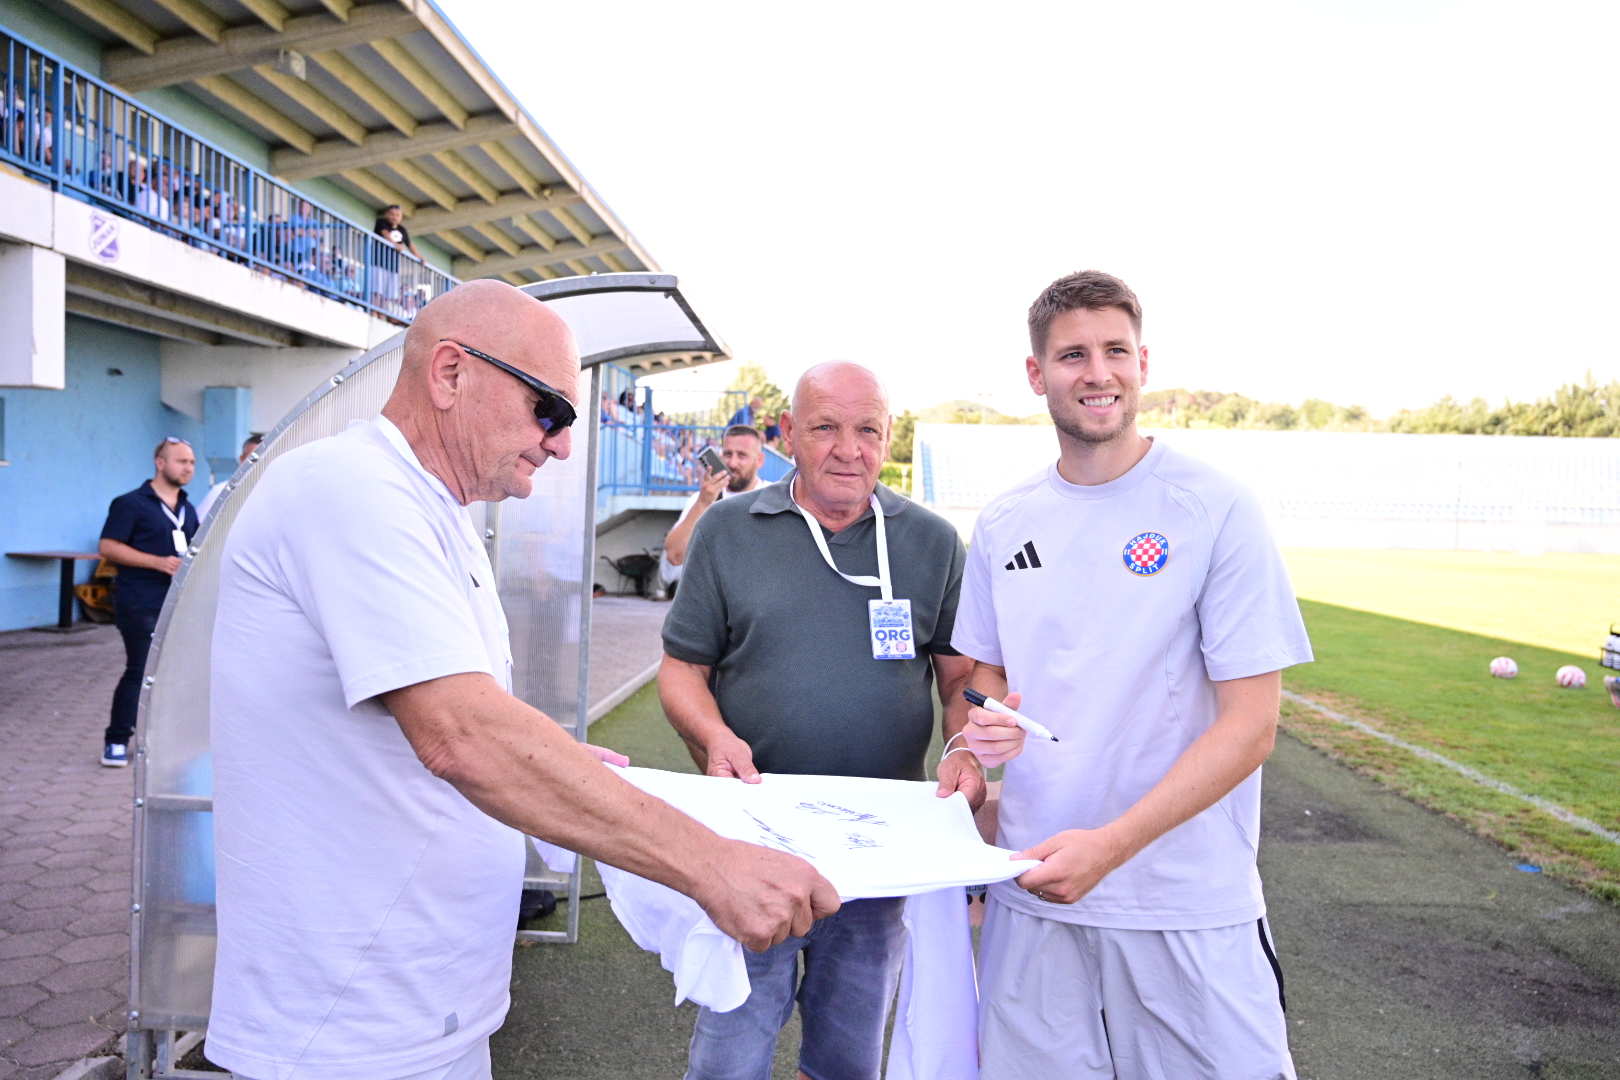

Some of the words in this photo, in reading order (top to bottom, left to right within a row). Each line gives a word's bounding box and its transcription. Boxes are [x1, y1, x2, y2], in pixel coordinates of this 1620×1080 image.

[1129, 533, 1166, 546] HAJDUK
[1129, 562, 1159, 574] SPLIT
[874, 629, 911, 642] ORG
